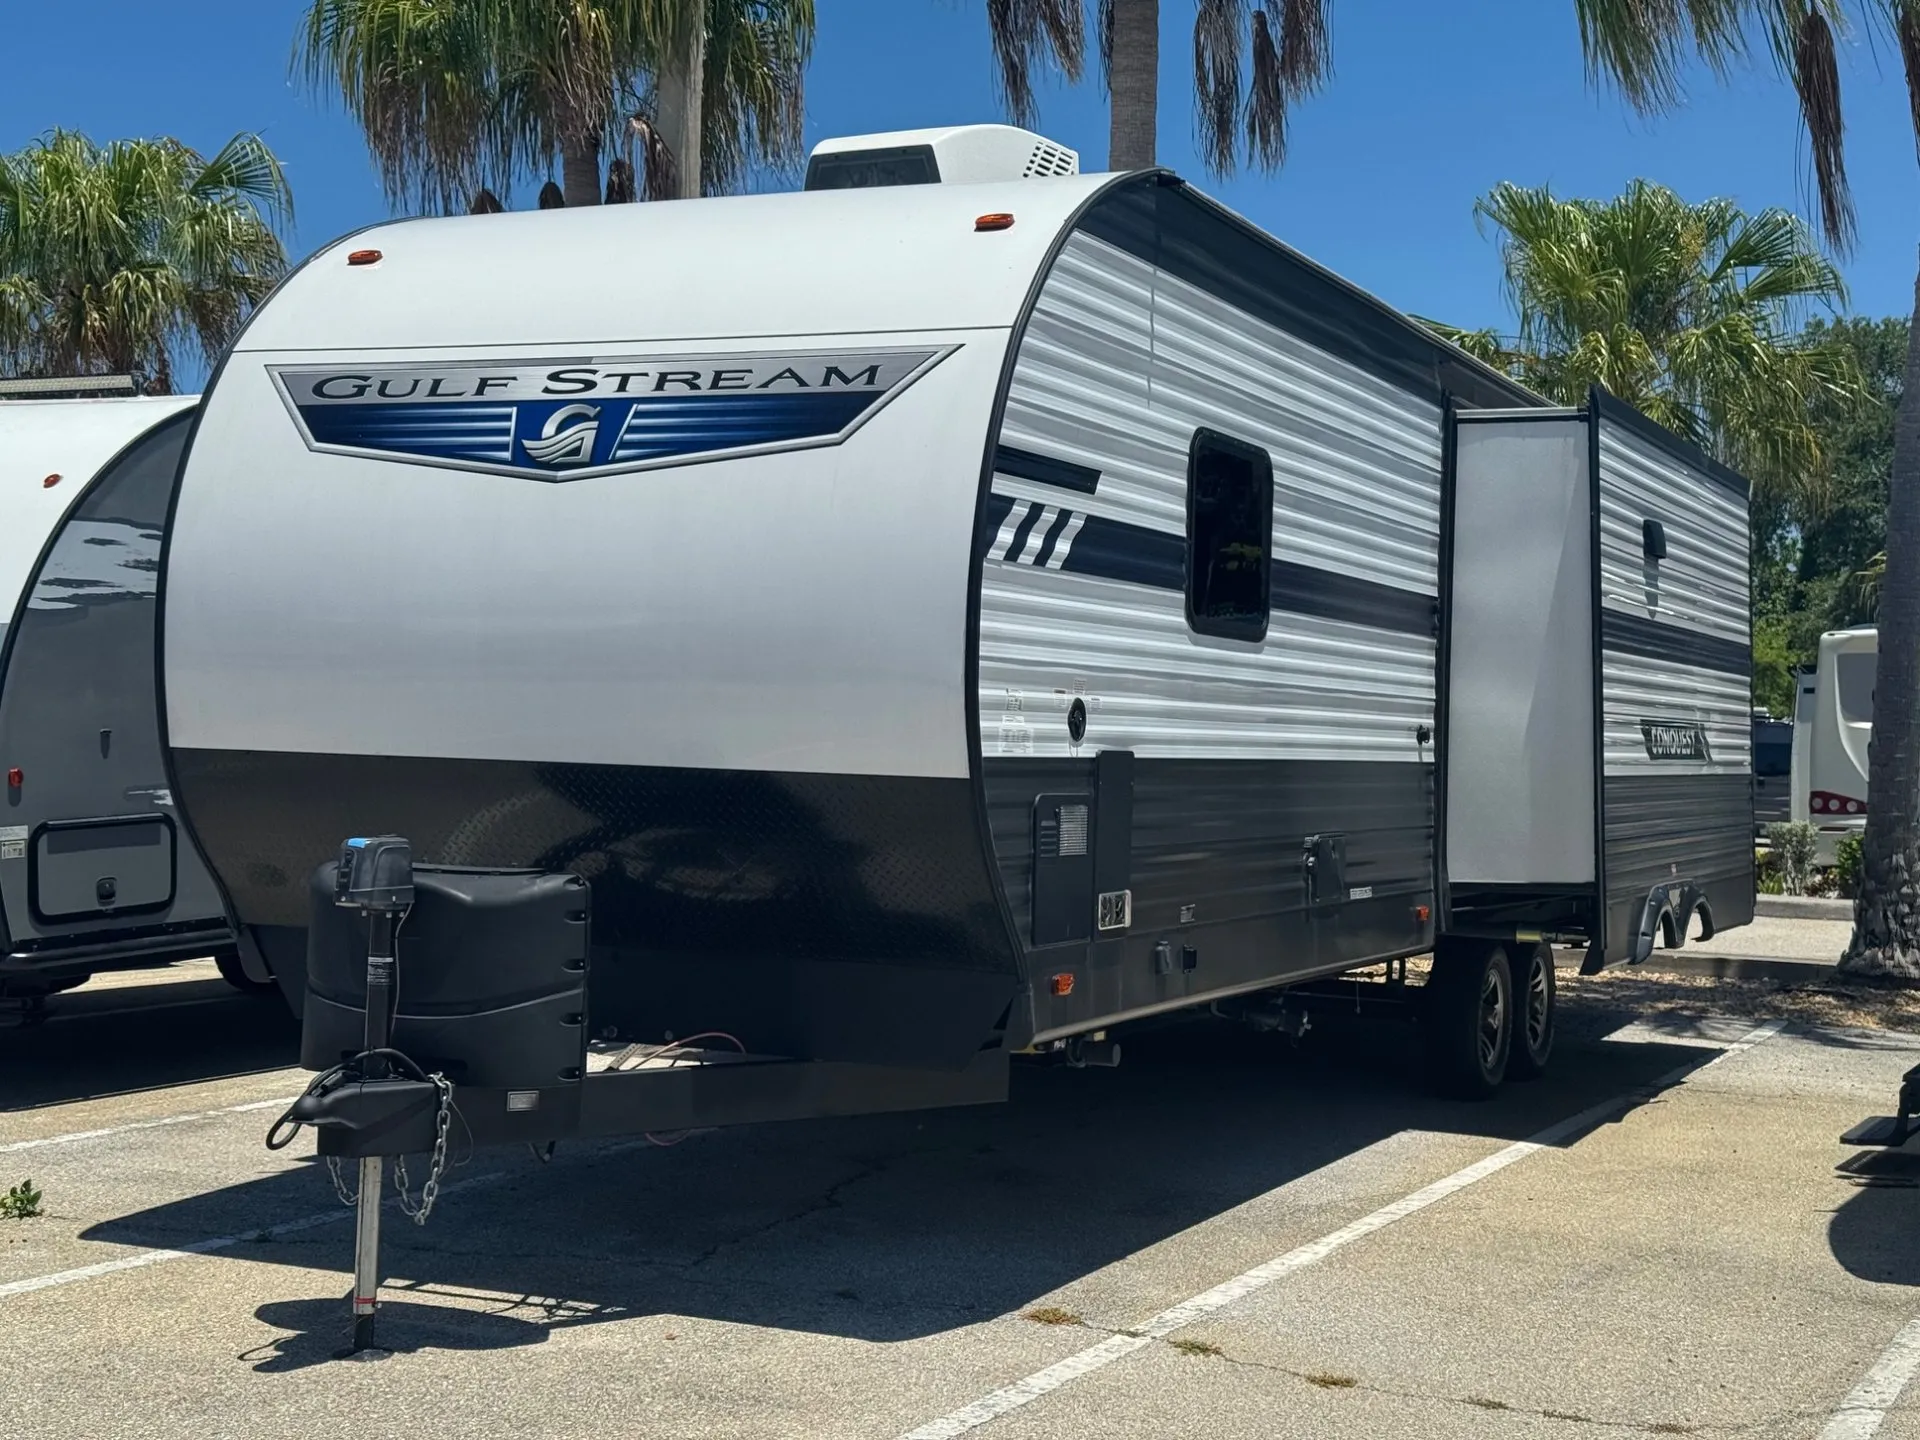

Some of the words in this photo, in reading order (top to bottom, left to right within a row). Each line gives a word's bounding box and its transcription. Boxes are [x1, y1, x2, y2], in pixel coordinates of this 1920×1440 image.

[311, 375, 518, 399] GULF
[541, 364, 885, 395] STREAM
[1651, 727, 1696, 755] CONQUEST
